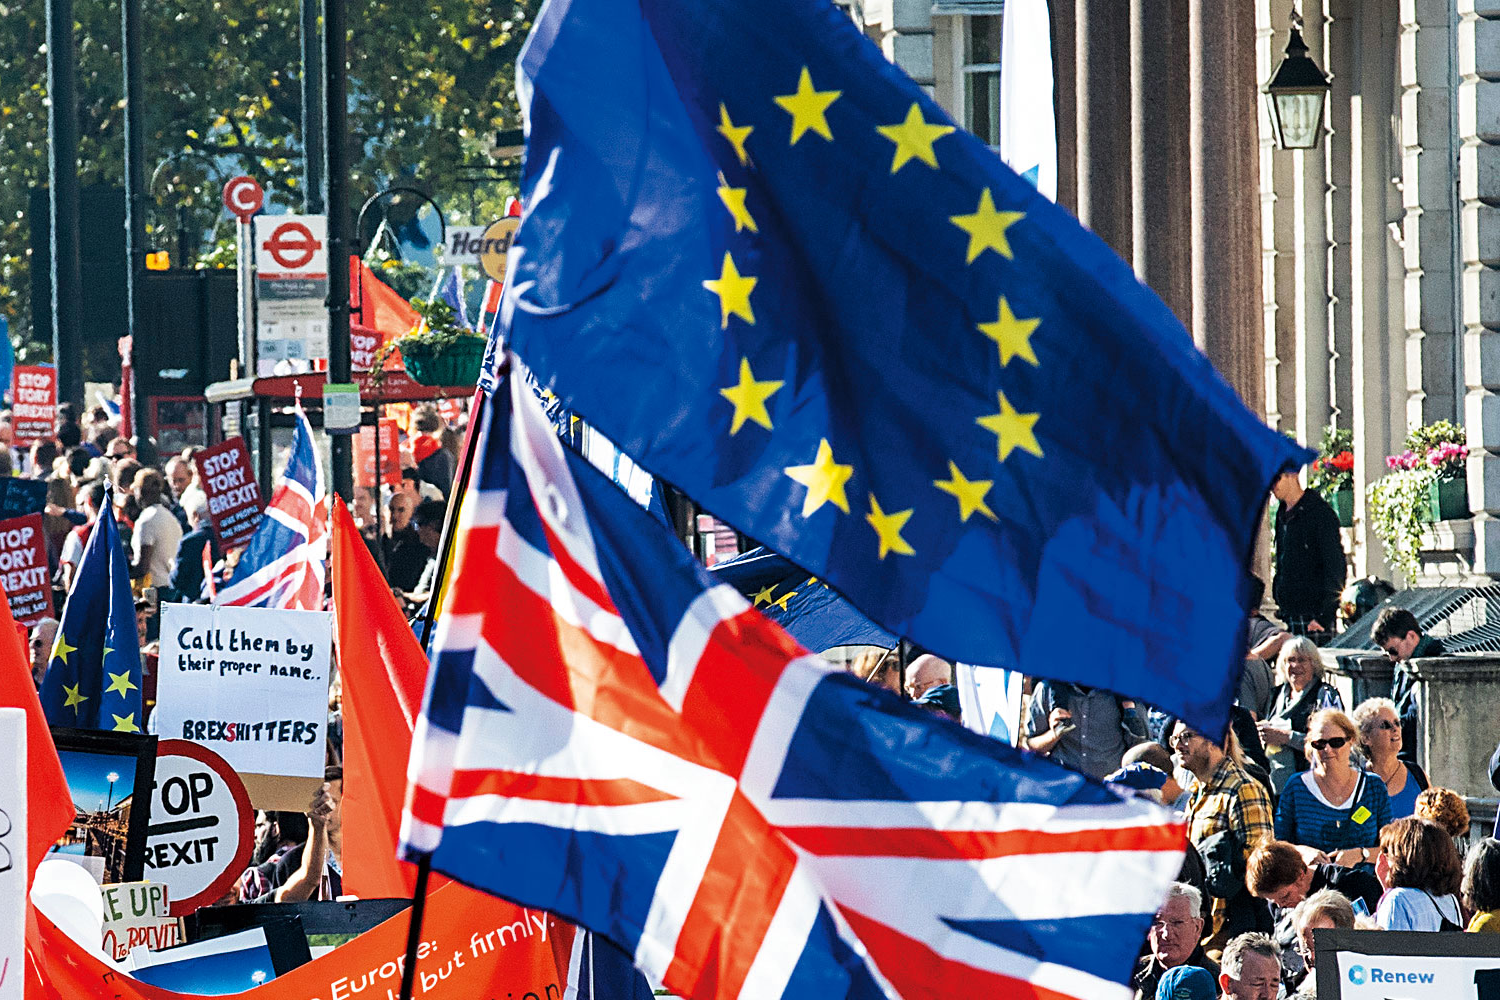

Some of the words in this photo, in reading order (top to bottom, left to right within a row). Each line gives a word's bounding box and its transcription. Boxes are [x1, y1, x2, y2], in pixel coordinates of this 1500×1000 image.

[232, 183, 256, 209] C
[451, 233, 512, 255] Hard
[202, 450, 241, 473] STOP
[210, 469, 245, 491] TORY
[210, 483, 258, 515] BREXIT
[178, 627, 224, 654] Call
[229, 630, 280, 654] them
[286, 638, 313, 661] by
[178, 654, 215, 672] their
[220, 658, 262, 678] proper
[183, 719, 318, 744] BREXSHITTERS
[1370, 968, 1435, 985] Renew
